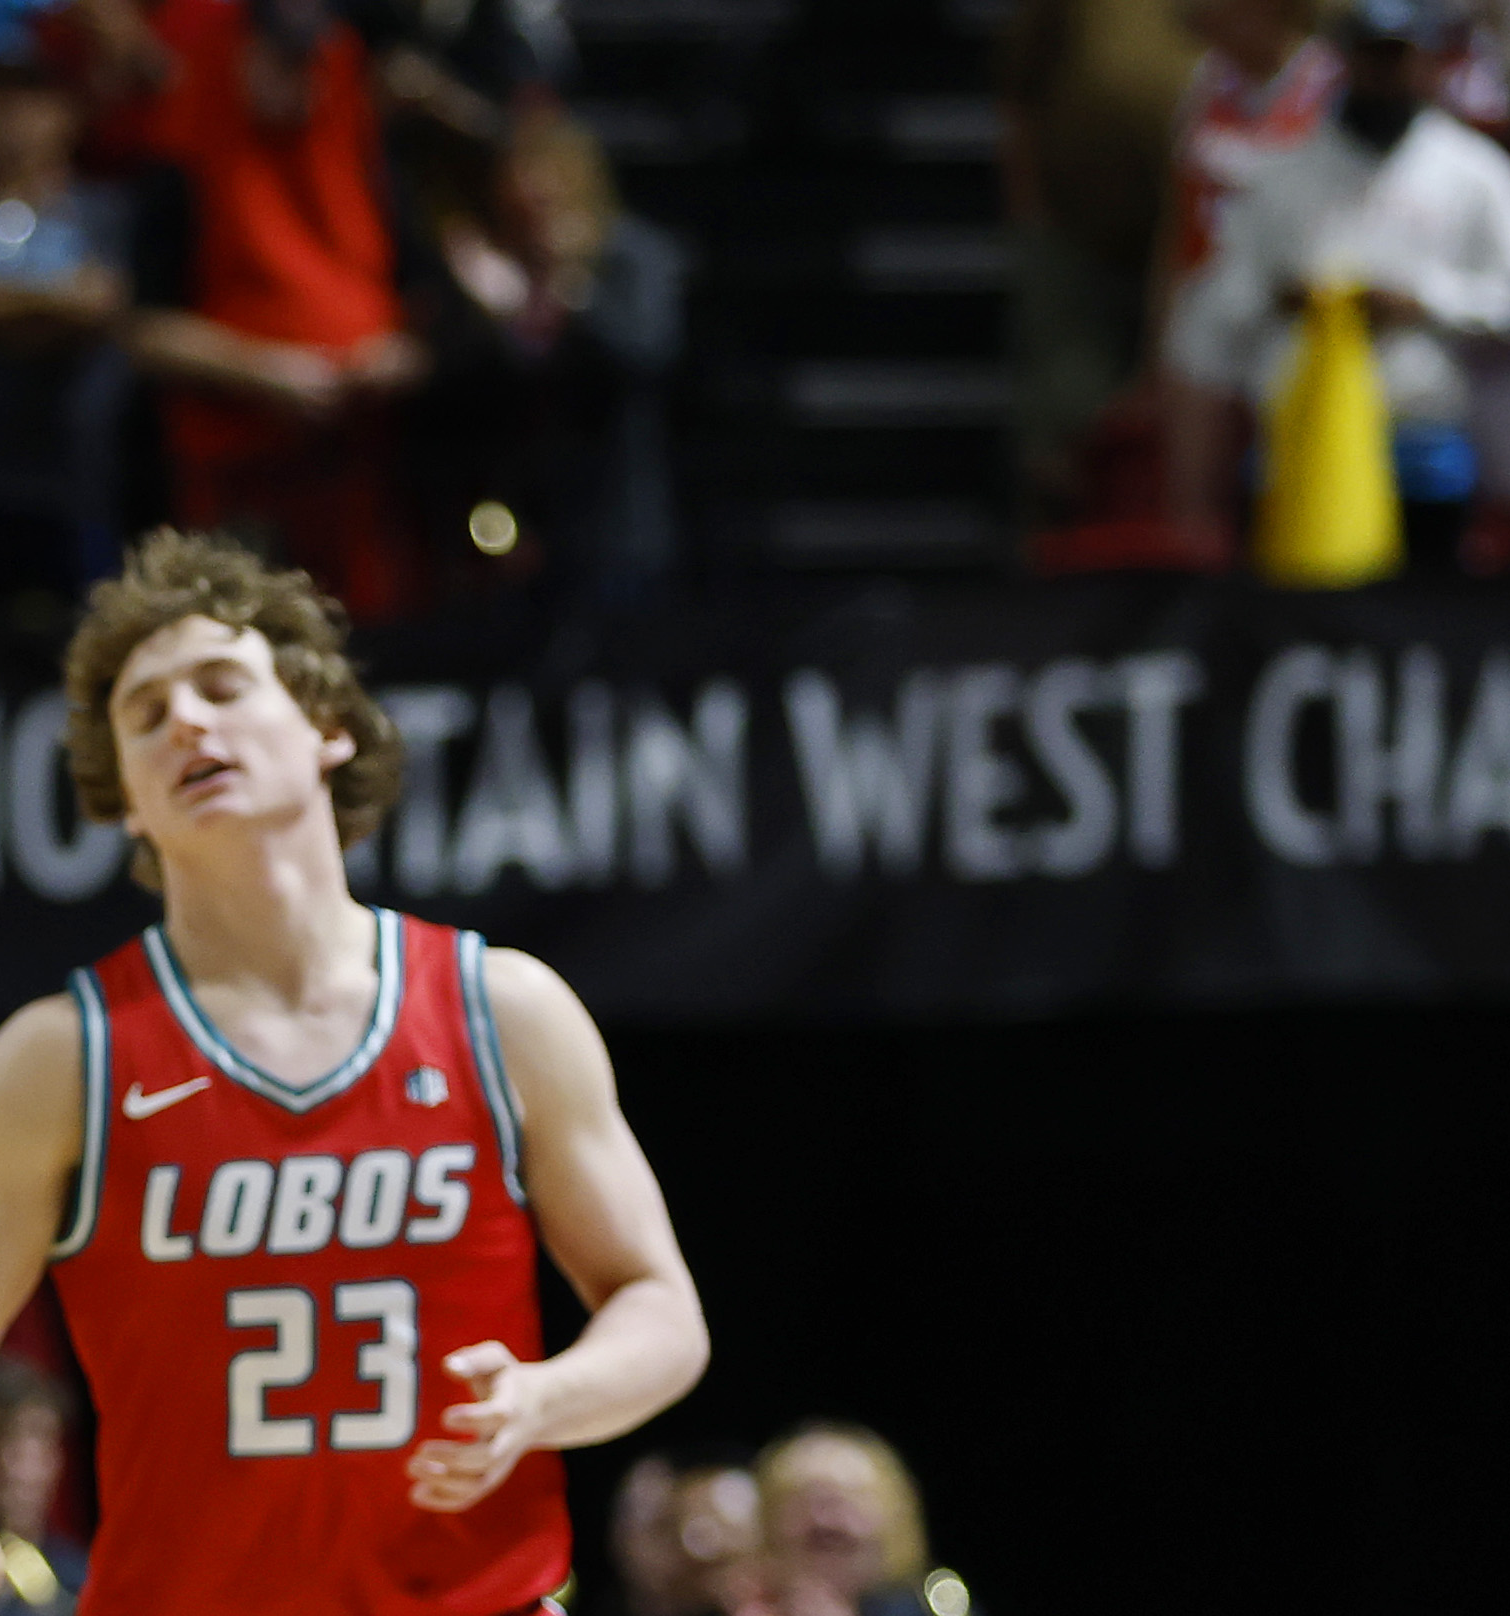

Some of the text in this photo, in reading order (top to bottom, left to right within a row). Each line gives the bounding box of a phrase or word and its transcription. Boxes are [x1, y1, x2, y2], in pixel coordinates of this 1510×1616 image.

[786, 647, 1206, 882] WEST
[141, 1143, 478, 1263] LOBOS
[226, 1277, 420, 1459] 23
